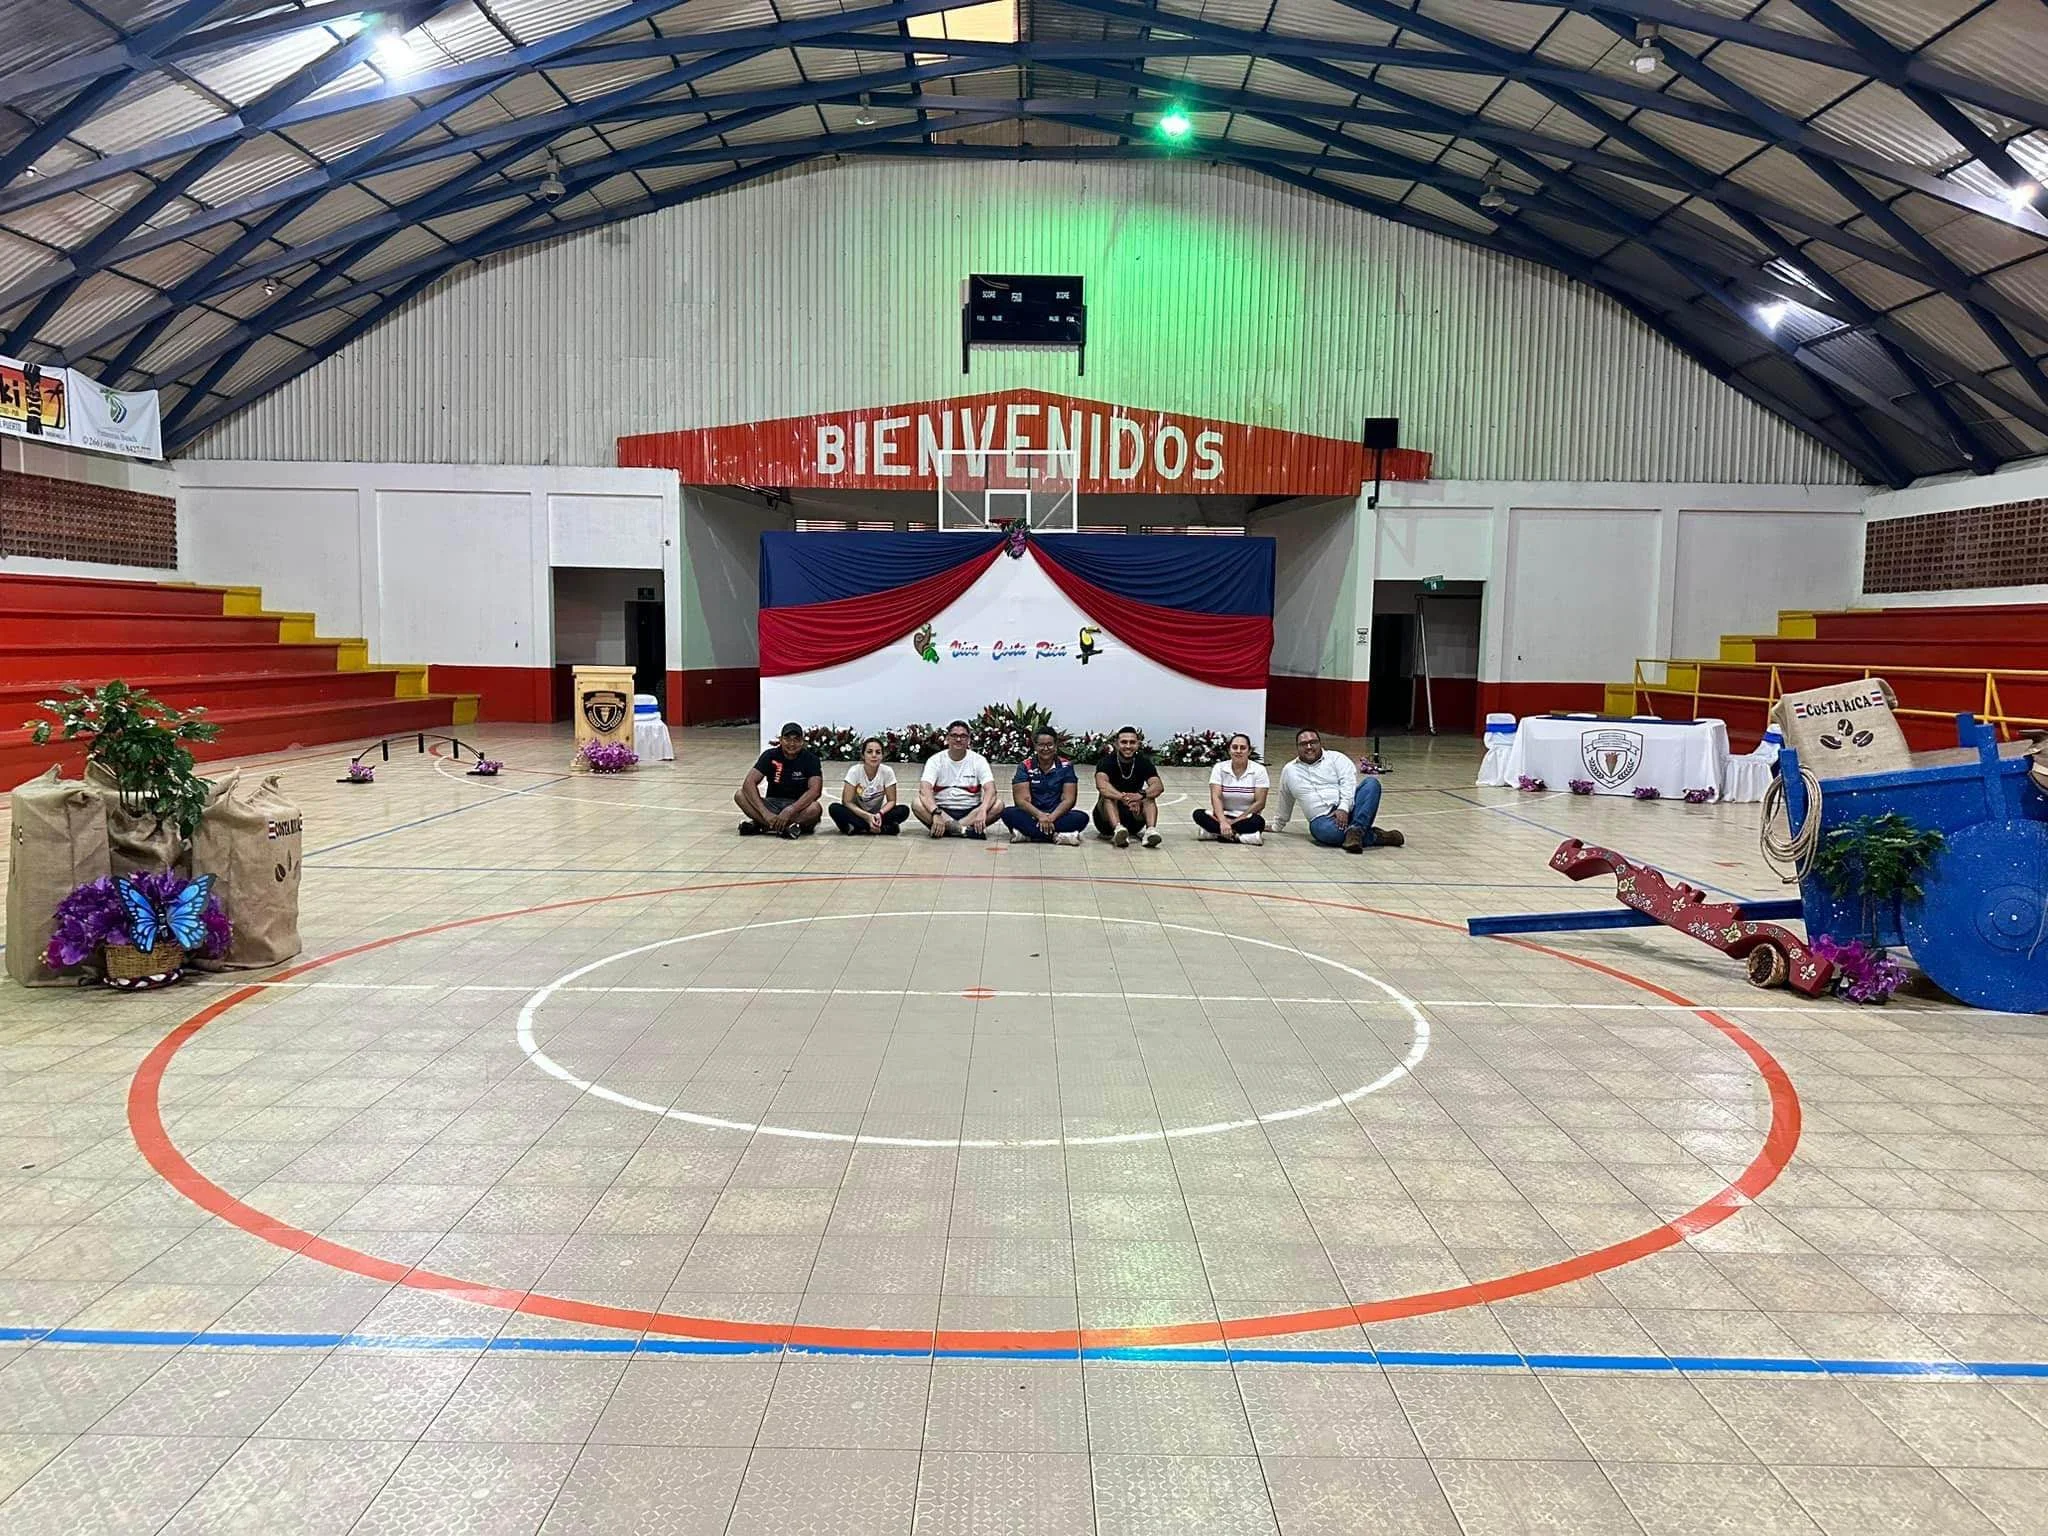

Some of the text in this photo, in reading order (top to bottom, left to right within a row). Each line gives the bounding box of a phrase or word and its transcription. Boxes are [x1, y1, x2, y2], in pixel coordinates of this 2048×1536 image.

[817, 404, 1225, 481] BIENVENIDOS
[949, 640, 1067, 661] Viva Costa Rica
[1806, 695, 1873, 716] COSTA RICA
